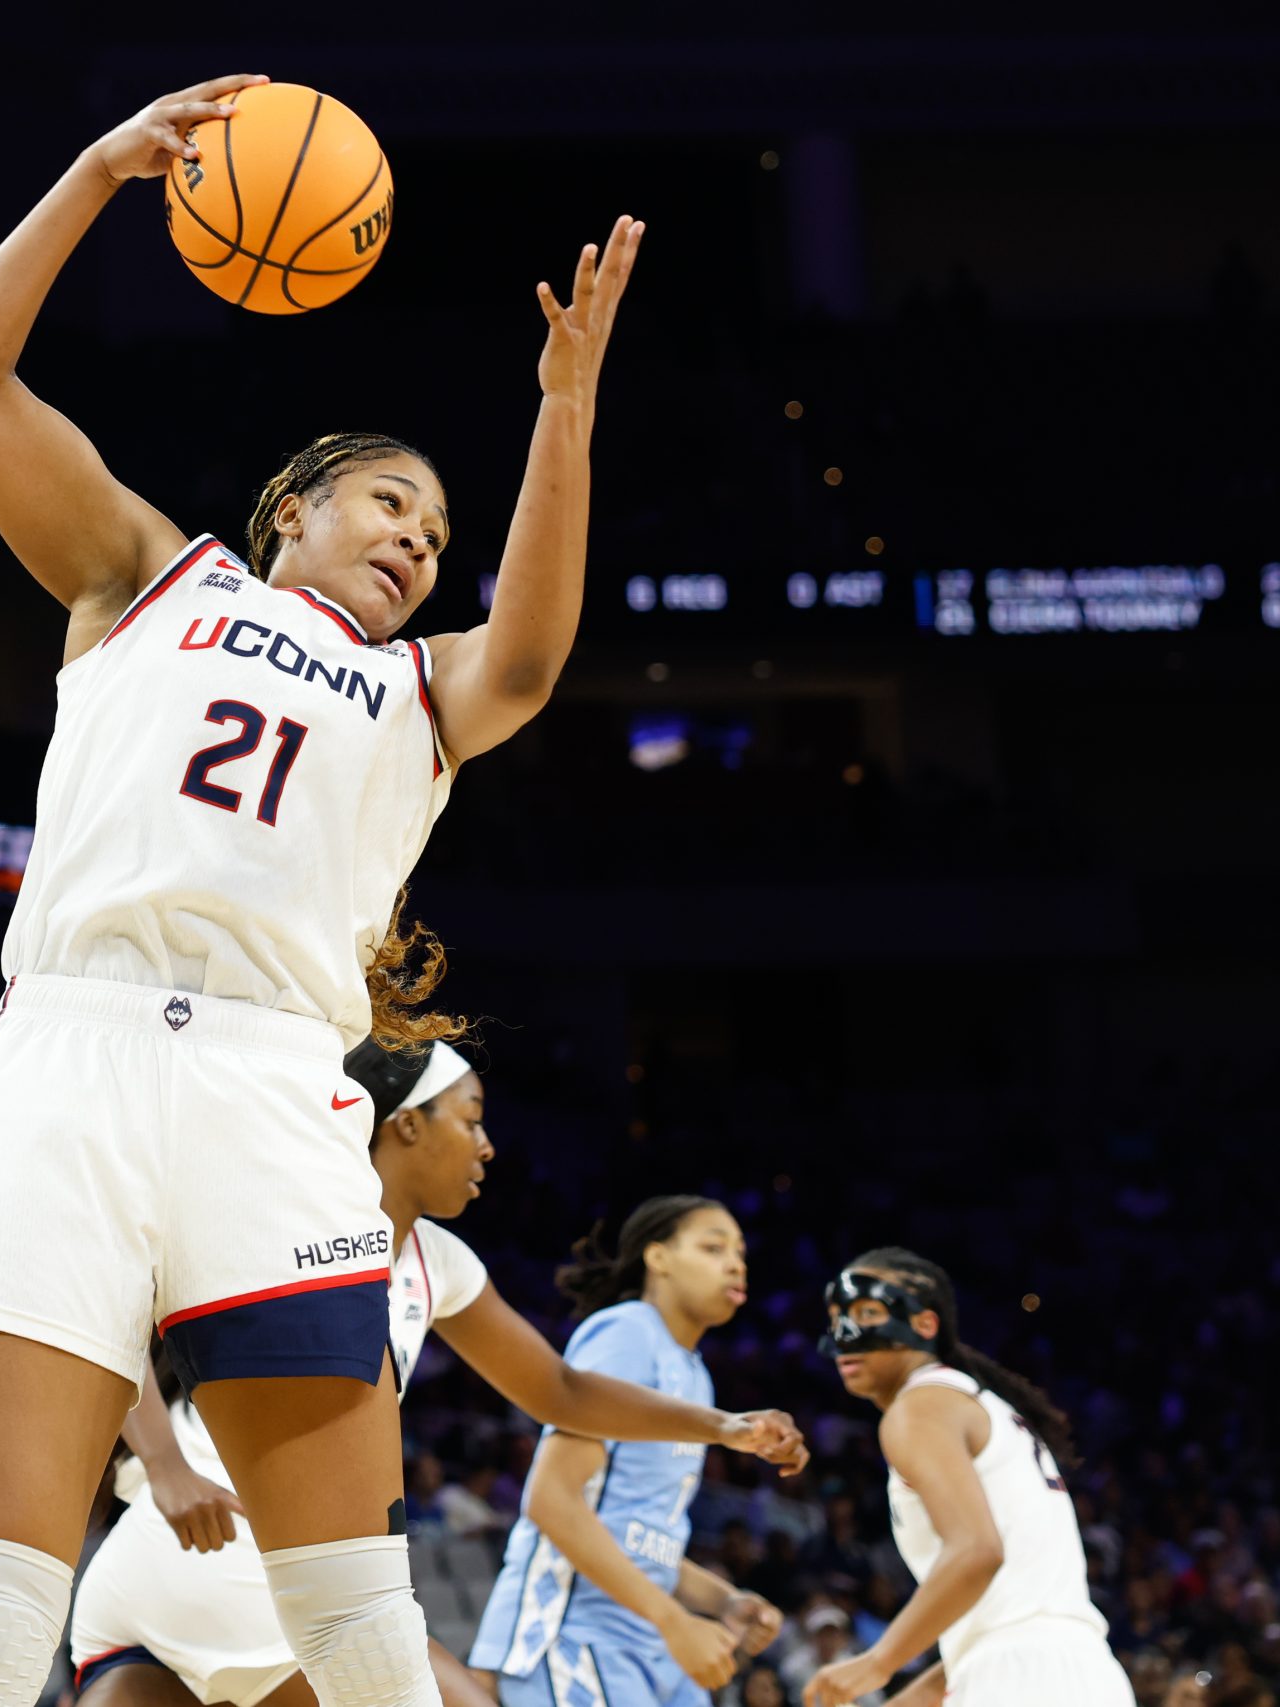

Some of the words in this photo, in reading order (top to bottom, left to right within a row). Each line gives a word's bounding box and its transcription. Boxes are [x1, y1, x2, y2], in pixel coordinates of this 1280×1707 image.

[350, 187, 393, 256] Wil
[198, 579, 242, 594] CHANGE
[206, 572, 222, 580] BE
[223, 574, 245, 586] THE
[178, 616, 387, 721] UCONN
[179, 698, 309, 827] 21
[293, 1230, 388, 1270] HUSKIES
[624, 1519, 682, 1570] CARO
